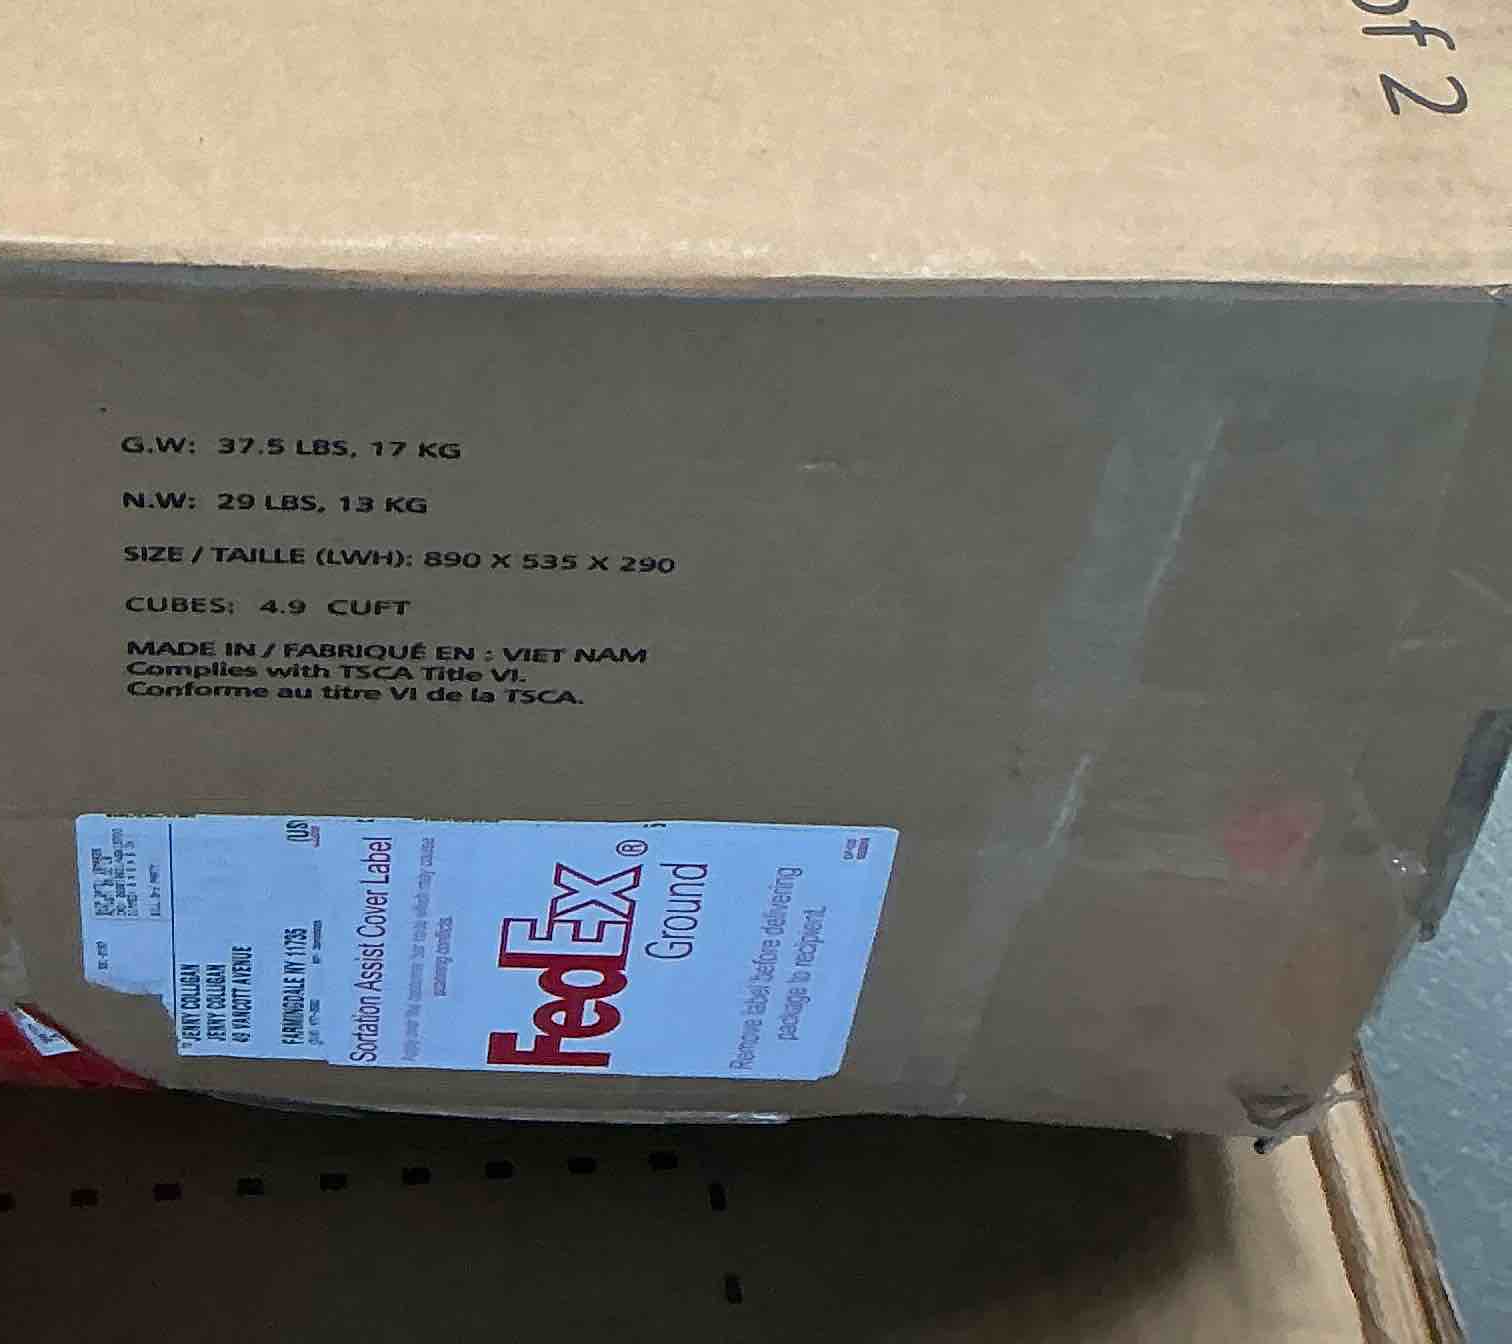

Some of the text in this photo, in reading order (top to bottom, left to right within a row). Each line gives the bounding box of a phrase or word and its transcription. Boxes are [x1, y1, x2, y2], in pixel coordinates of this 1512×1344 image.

[1378, 73, 1469, 117] 2
[120, 435, 461, 460] G.W: 37.5 LBS, 17 KG
[123, 545, 676, 575] SIZE TAILLE (LWH): 890 X 535 X 290
[124, 595, 412, 617] CUBES: 4.9 CUFT
[127, 640, 648, 665] MADE IN FABRIQUÉ EN VIET NAM
[126, 680, 585, 705] Conforme au titre VI de la TSCA.
[349, 836, 393, 1062] Sortation Assist Cover Label
[644, 863, 709, 960] Ground
[179, 963, 202, 1041] JENNY COLLIGAN
[281, 928, 308, 1045] FARMINGDALE NY 11735
[486, 863, 642, 1068] FedEx
[728, 867, 804, 1070] Remove label before delivering
[777, 905, 827, 1041] package to recipient.
